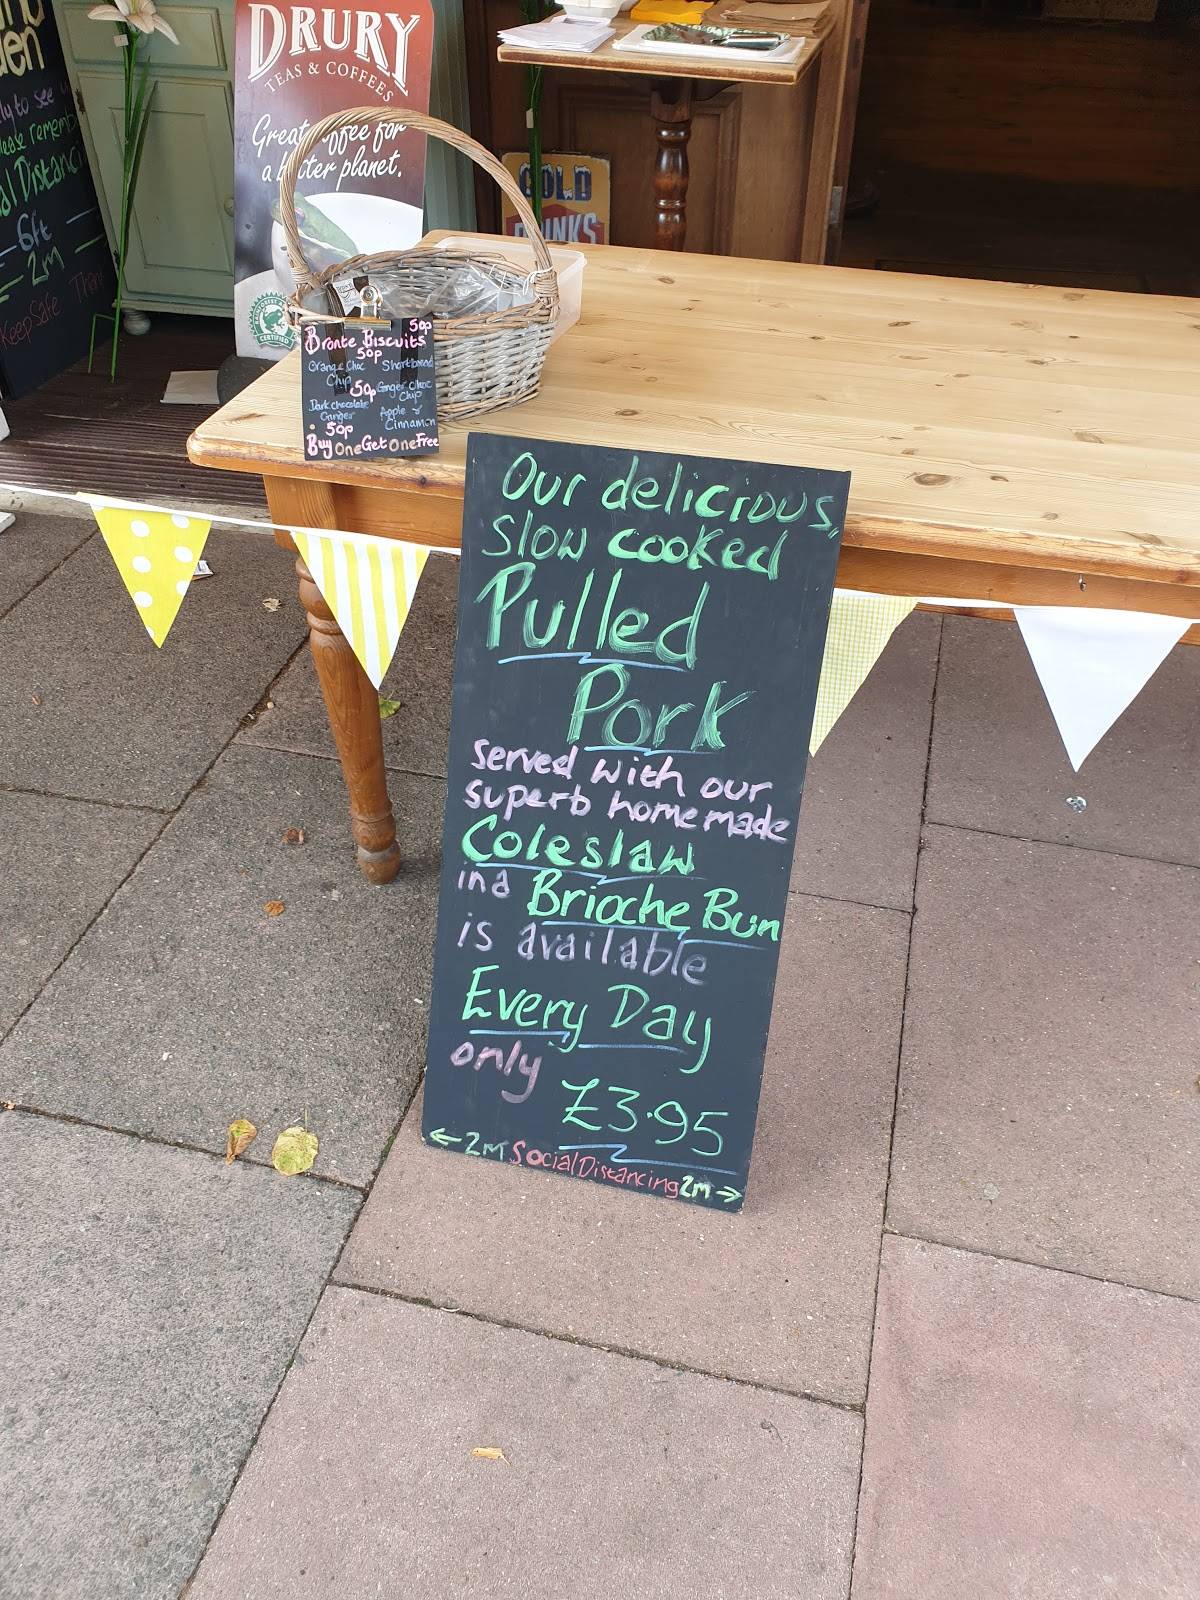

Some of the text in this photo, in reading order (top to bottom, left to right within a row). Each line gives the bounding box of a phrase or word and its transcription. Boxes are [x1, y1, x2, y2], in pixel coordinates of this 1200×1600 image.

[248, 3, 421, 97] DRURY
[264, 61, 394, 102] TEAS & COFFEES
[252, 113, 310, 158] Great
[372, 121, 407, 153] for
[261, 164, 272, 182] a
[335, 145, 402, 192] planet.
[16, 210, 52, 251] 6ft
[304, 325, 426, 355] Bronte Biscuits
[409, 318, 432, 335] 50p
[355, 348, 382, 364] 50p
[326, 373, 352, 392] Chip
[350, 380, 377, 403] 50p
[399, 391, 423, 405] Chip
[326, 422, 354, 440] 50p
[380, 404, 406, 421] Apple
[384, 419, 436, 431] Cinnamon
[306, 433, 332, 459] Buy
[362, 435, 388, 451] Get
[416, 432, 440, 448] Free
[502, 452, 587, 507] Our
[607, 525, 789, 581] cooked
[474, 561, 710, 671] Pulled
[566, 663, 757, 751] Pork
[590, 756, 686, 798] with
[700, 777, 773, 803] our
[461, 814, 697, 876] Coleslaw
[527, 869, 691, 932] Brioche
[702, 888, 781, 942] Bun
[457, 912, 708, 986] is available
[461, 965, 712, 1074] Every Day
